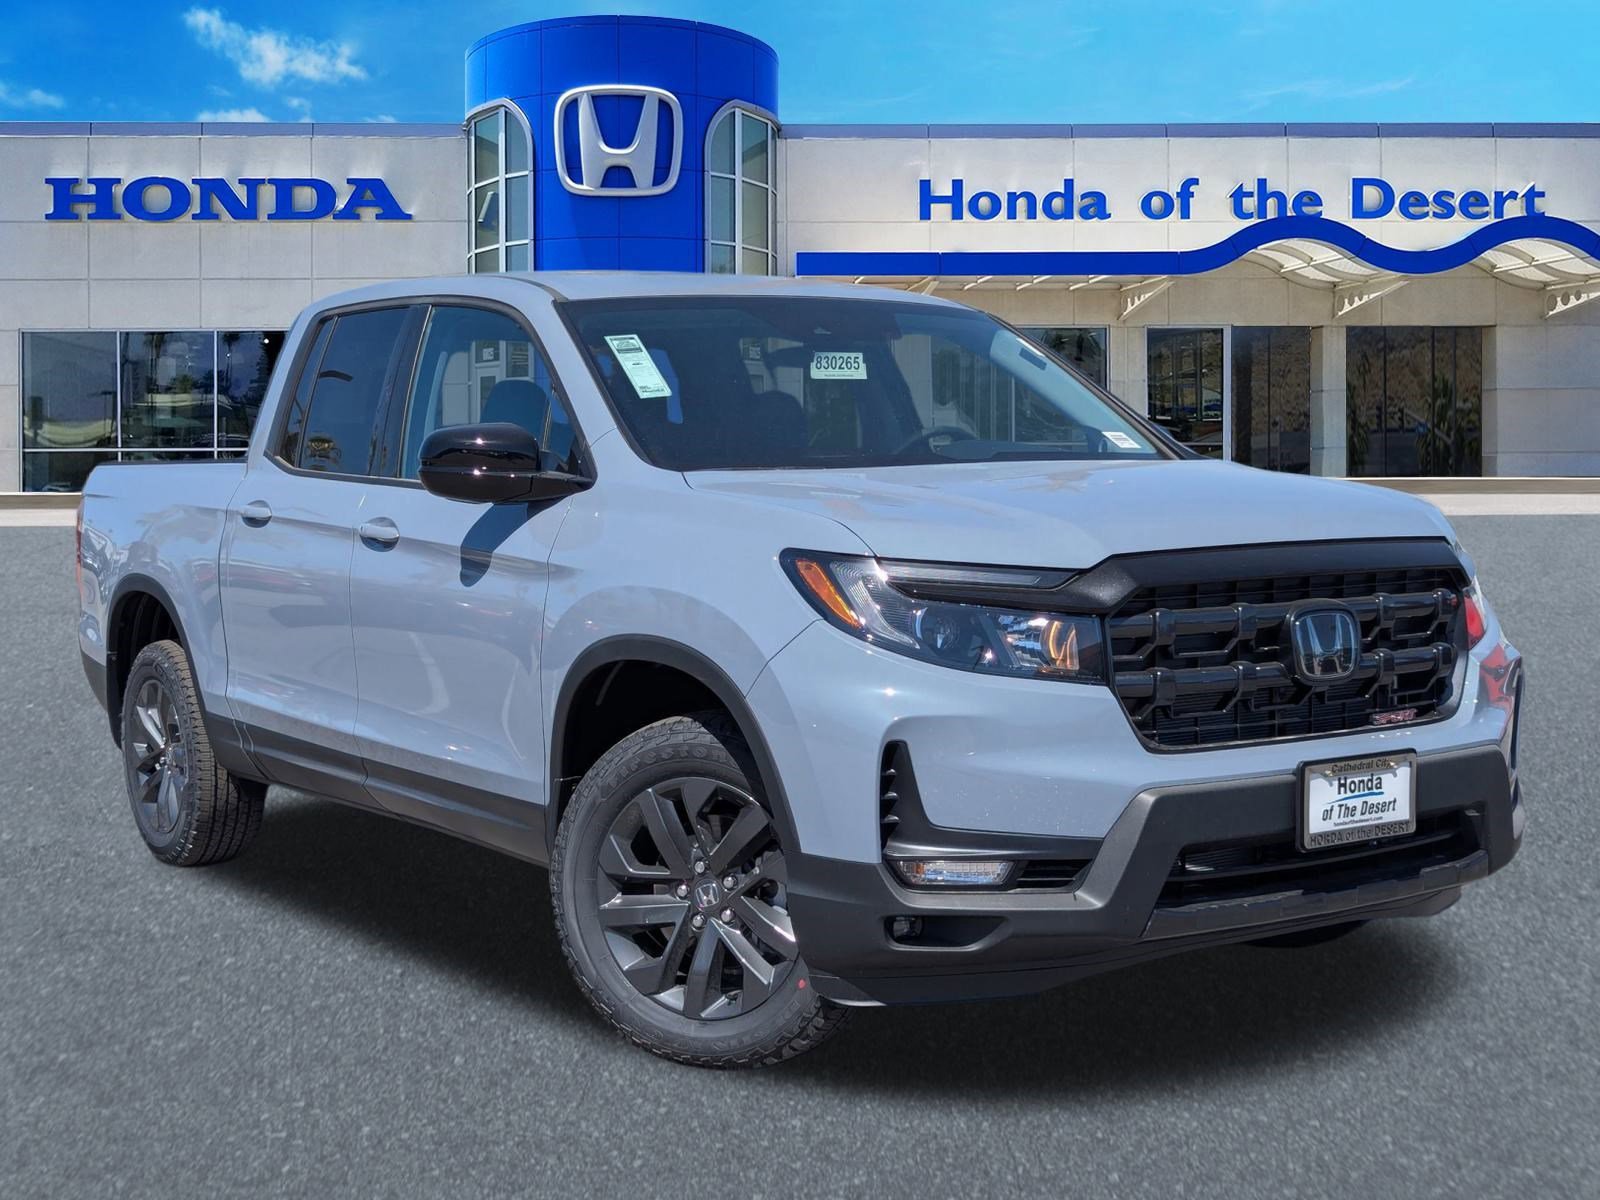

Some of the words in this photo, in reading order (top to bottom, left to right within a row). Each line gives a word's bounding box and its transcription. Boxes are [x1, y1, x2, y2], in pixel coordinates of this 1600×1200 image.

[45, 176, 413, 221] HONDA
[919, 178, 1112, 221] Honda
[1140, 177, 1200, 220] of
[1229, 177, 1324, 220] the
[1351, 177, 1546, 221] Desert
[815, 355, 860, 370] 830265
[1331, 760, 1374, 773] Cathedral
[1337, 773, 1383, 795] Honda
[1322, 804, 1334, 821] of
[1337, 803, 1358, 819] The
[1360, 798, 1397, 816] Desert
[1310, 831, 1343, 847] HONDA
[1345, 829, 1355, 840] of
[1357, 825, 1372, 838] the
[1374, 821, 1410, 836] DESERT
